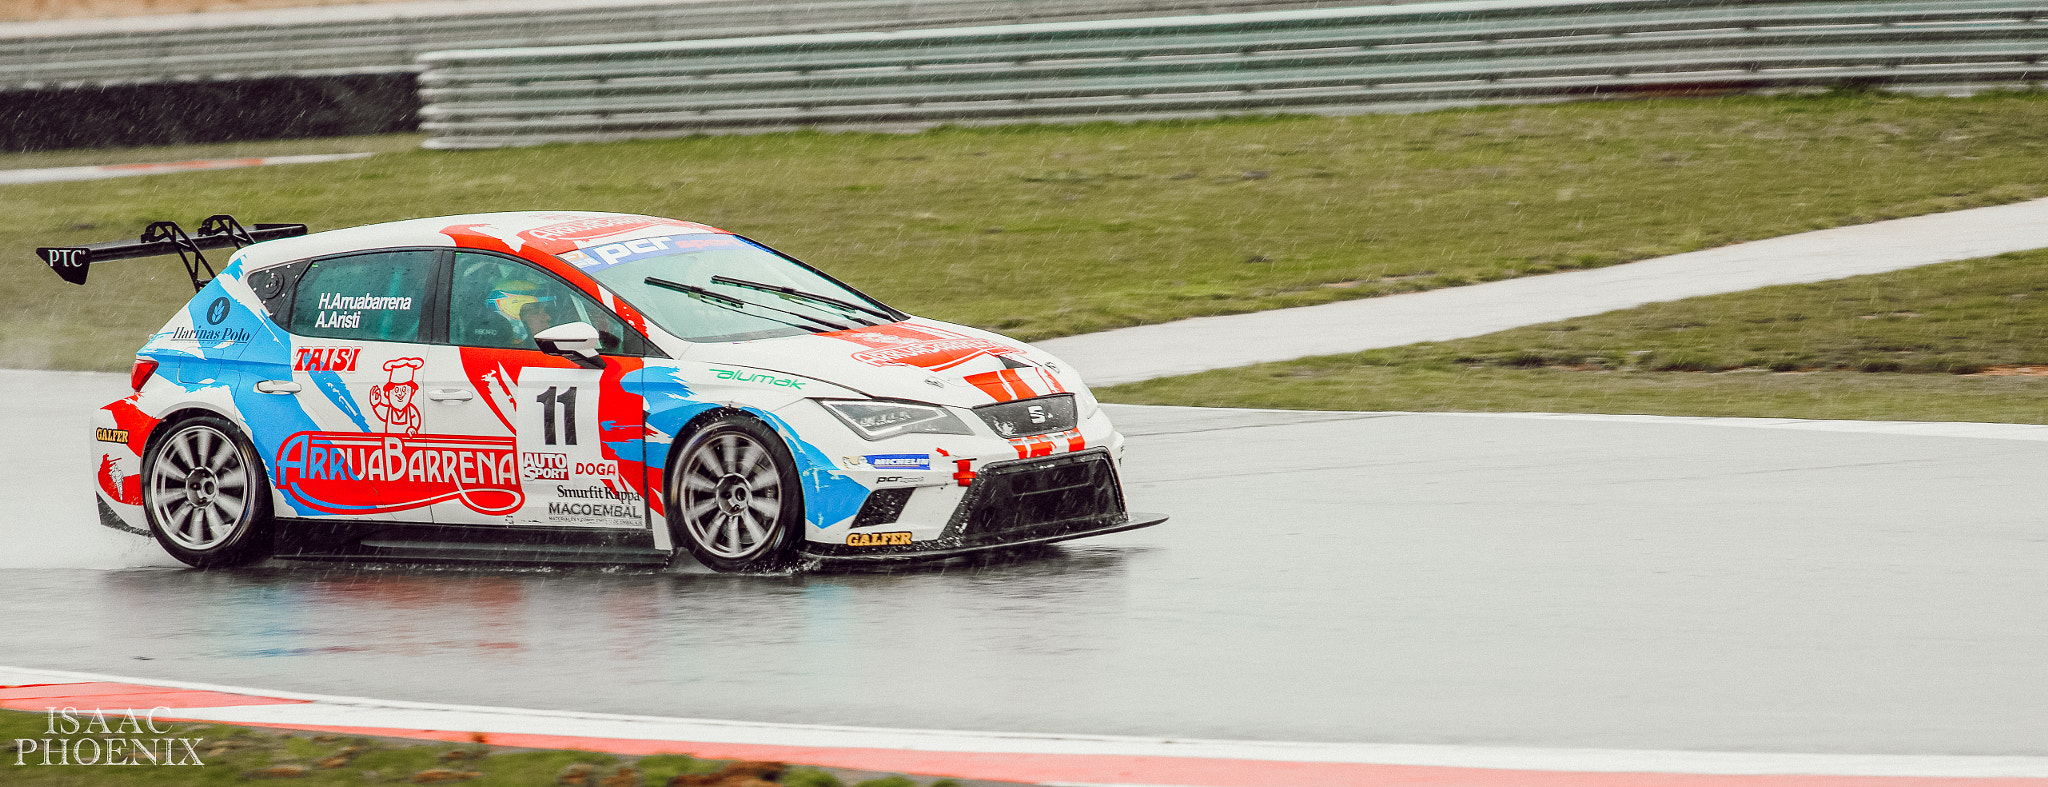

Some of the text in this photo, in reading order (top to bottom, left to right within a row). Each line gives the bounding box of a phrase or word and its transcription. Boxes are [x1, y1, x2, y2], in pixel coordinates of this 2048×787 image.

[596, 236, 673, 266] pcr
[318, 292, 412, 310] H.Arruabarrena
[315, 311, 361, 329] A.Aristi
[173, 325, 250, 342] Harinas Polo
[293, 347, 363, 372] TAISI
[709, 368, 806, 390] alumak
[536, 386, 577, 445] 11
[96, 428, 129, 444] GALFER
[523, 453, 567, 469] AUTO
[575, 463, 616, 476] DOGA
[523, 467, 568, 480] SPORT
[557, 484, 641, 504] Smurfit Kappa
[548, 502, 642, 518] MACOEMBAL
[846, 532, 912, 546] GALFER
